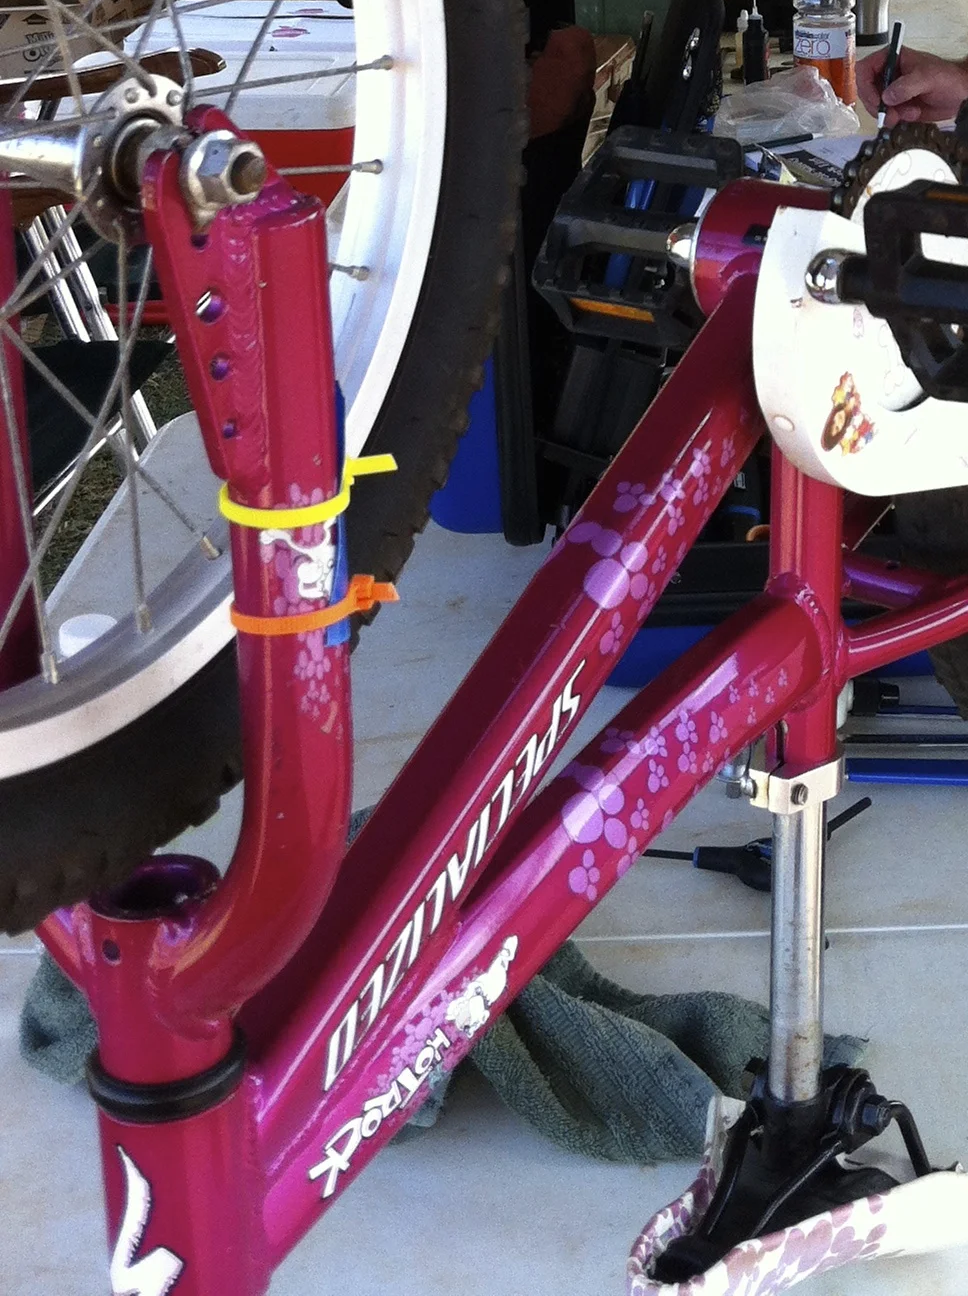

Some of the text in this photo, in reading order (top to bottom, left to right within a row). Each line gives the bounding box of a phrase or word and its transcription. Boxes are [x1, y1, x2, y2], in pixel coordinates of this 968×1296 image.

[795, 38, 831, 56] zero
[323, 659, 587, 1092] SPECIALIZED
[308, 1026, 451, 1199] HOTROCK
